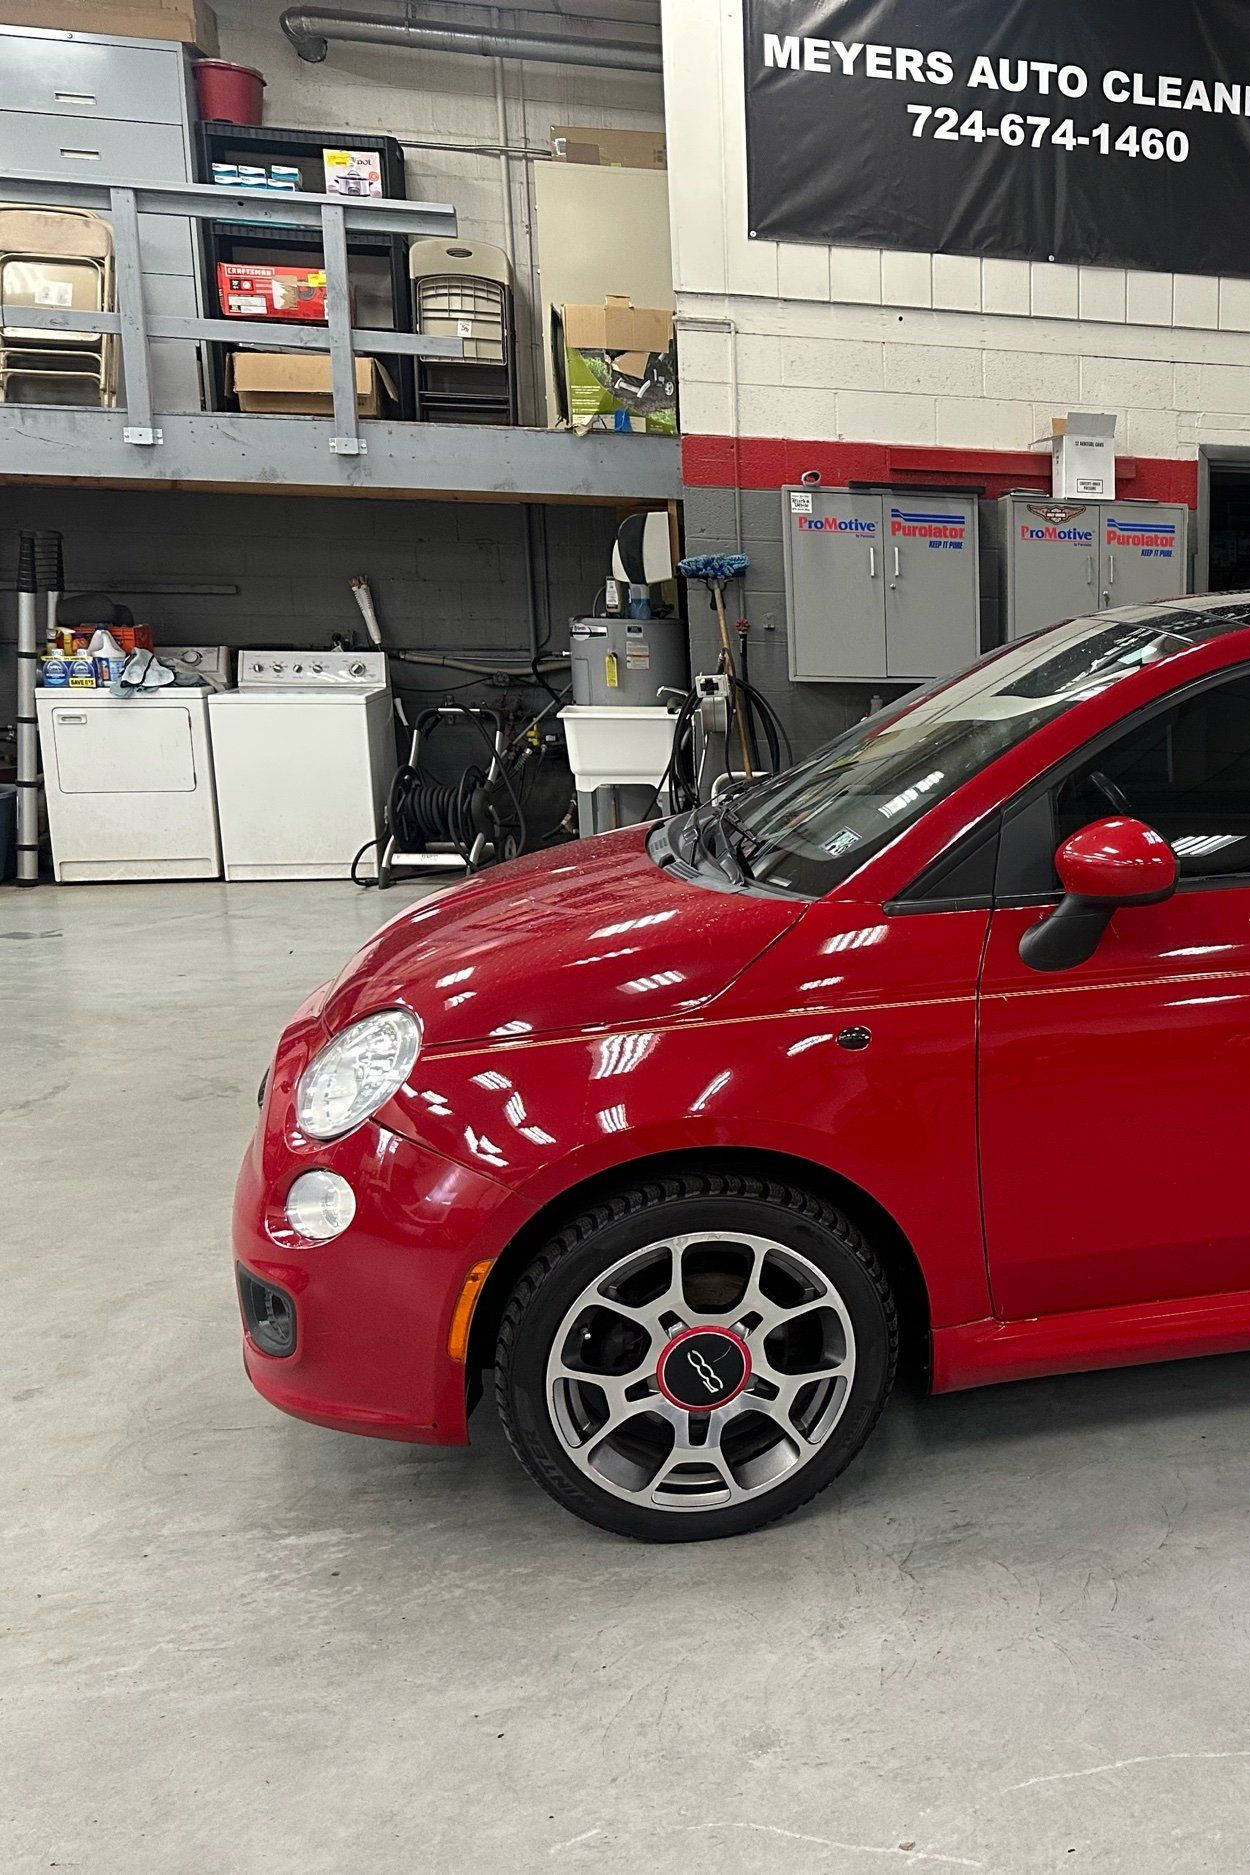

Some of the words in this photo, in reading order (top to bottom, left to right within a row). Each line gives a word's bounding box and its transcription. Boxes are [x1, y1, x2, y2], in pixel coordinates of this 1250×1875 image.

[763, 34, 954, 85] MEYERS
[967, 55, 1088, 99] AUTO
[906, 104, 1189, 163] 724-674-1460
[227, 267, 272, 276] CRAFTSMAN
[798, 516, 876, 532] ProMotive
[891, 521, 965, 538] Purolator
[1021, 525, 1093, 540] ProMotive
[1106, 530, 1175, 547] Purolator
[949, 541, 963, 549] PURE
